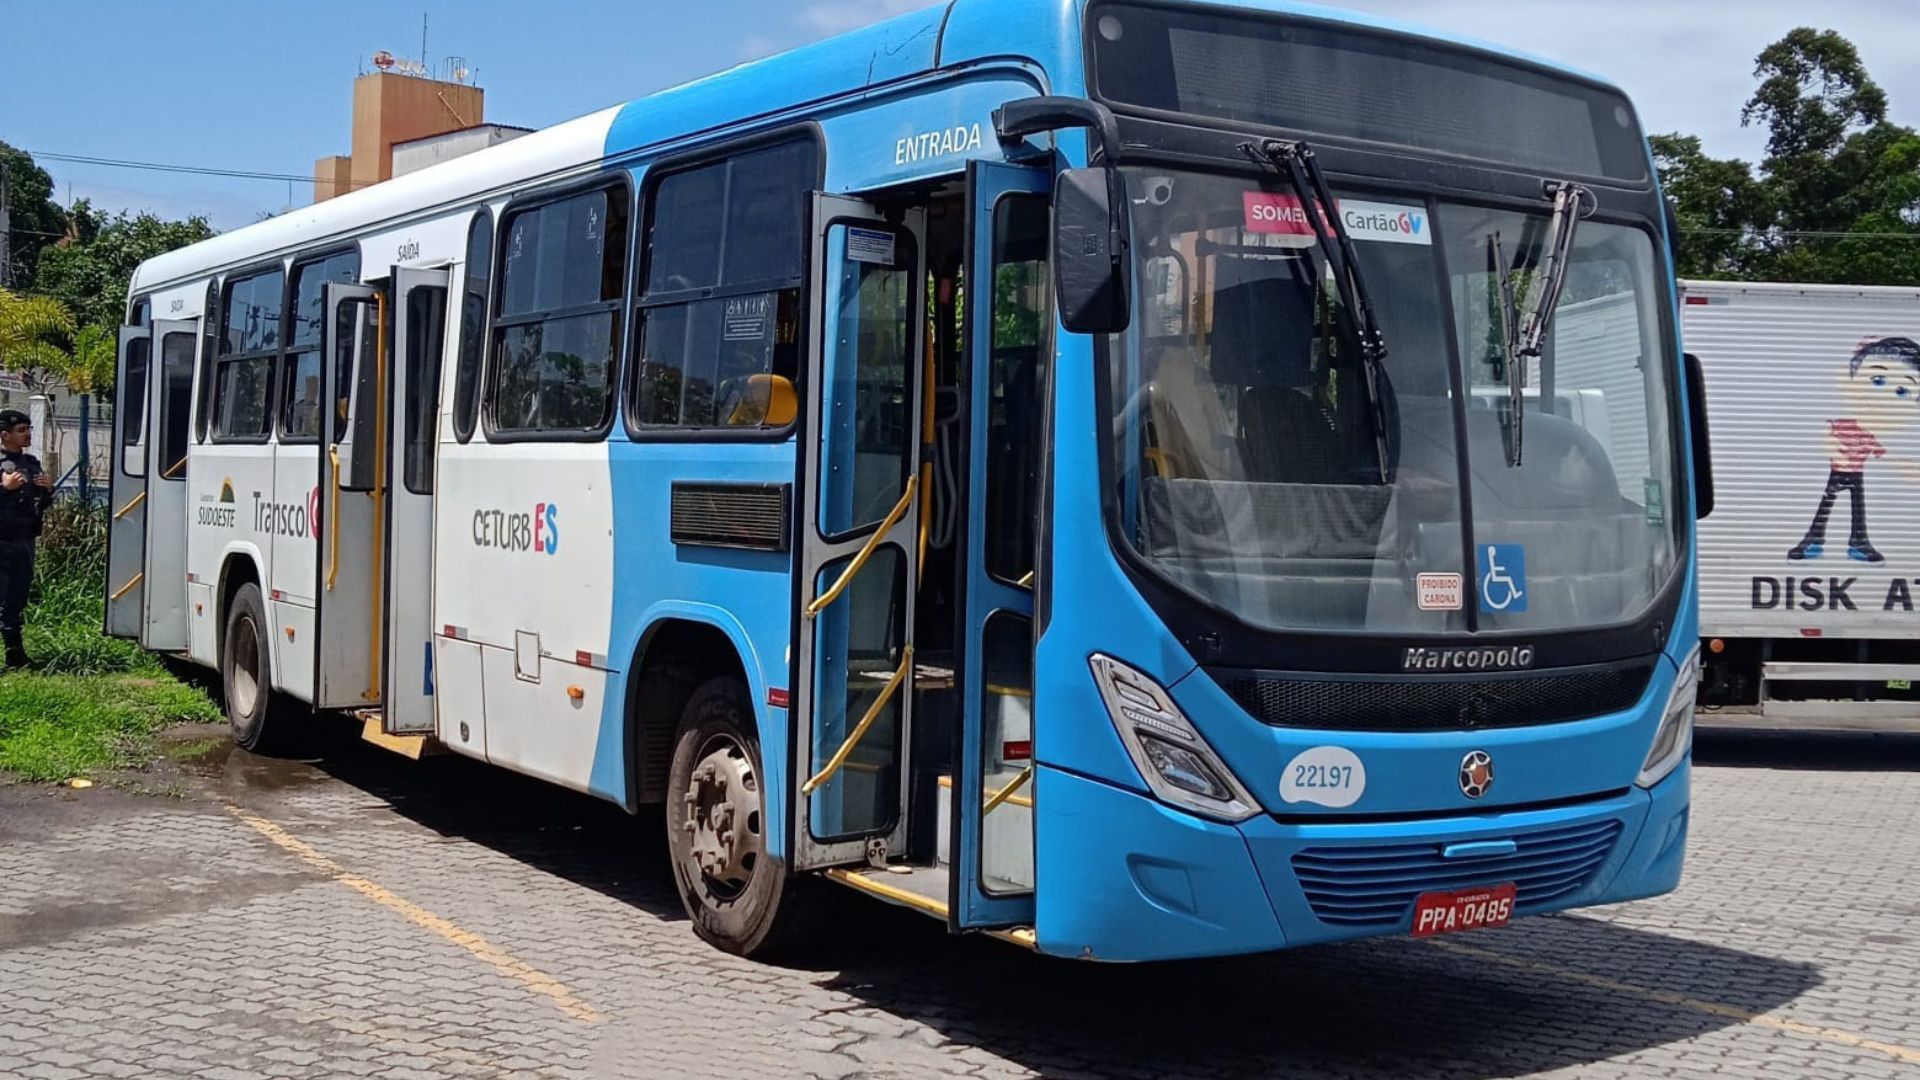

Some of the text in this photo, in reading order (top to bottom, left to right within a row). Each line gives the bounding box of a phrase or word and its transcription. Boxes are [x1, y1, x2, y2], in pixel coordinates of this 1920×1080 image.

[896, 123, 982, 166] ENTRADA
[198, 505, 235, 528] SUDOESTE
[1421, 579, 1458, 589] PROIBIDO
[1752, 576, 1858, 611] DISK
[1425, 594, 1456, 603] CARONA
[1404, 646, 1532, 668] Marcopolo
[1294, 765, 1352, 788] 22197
